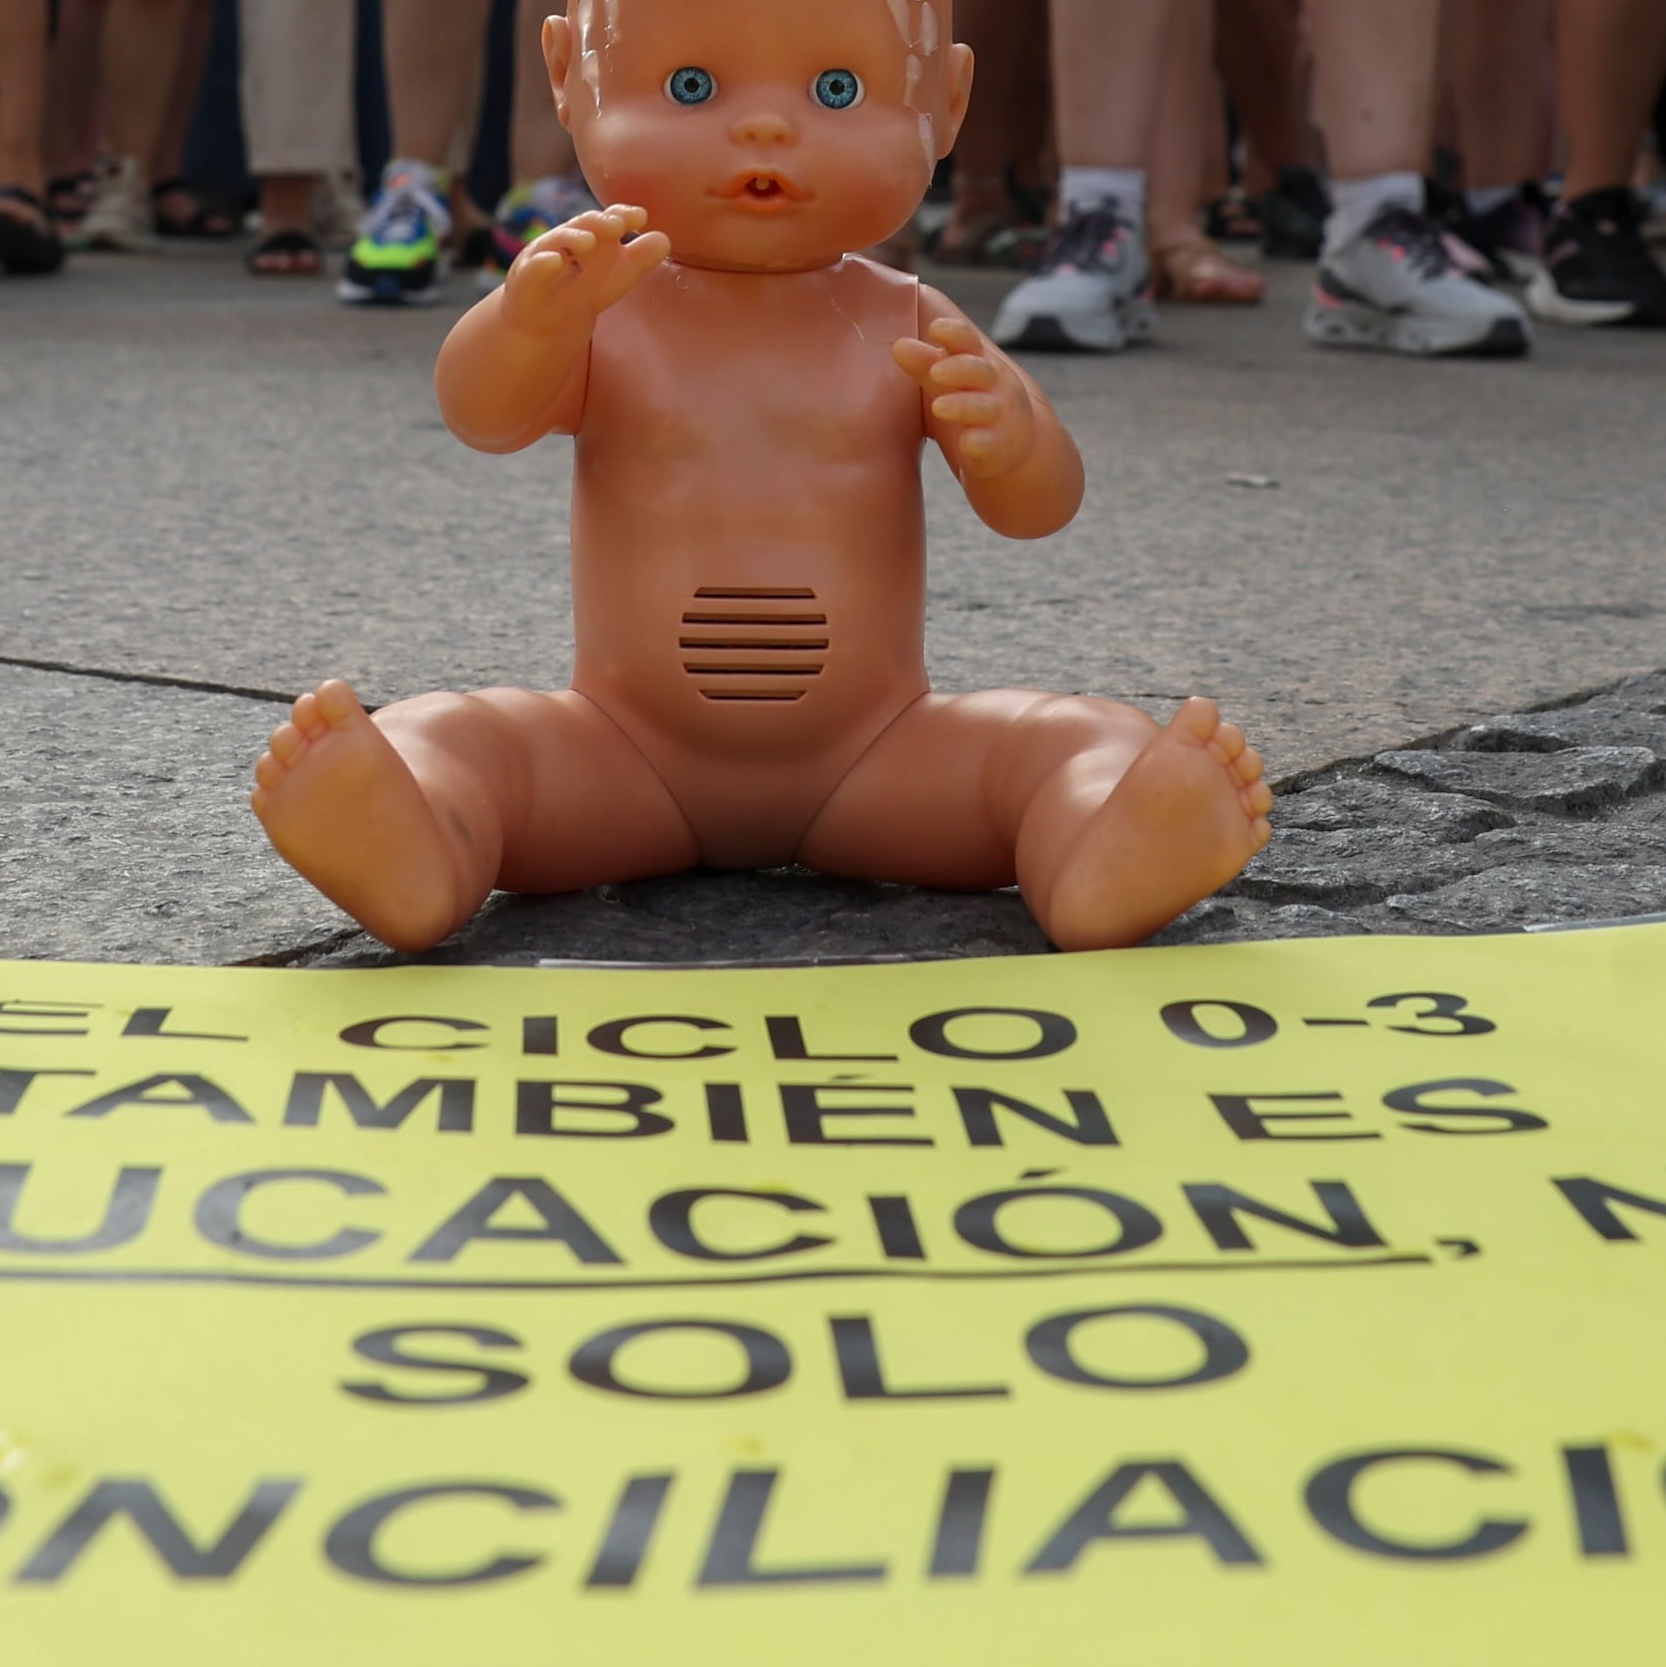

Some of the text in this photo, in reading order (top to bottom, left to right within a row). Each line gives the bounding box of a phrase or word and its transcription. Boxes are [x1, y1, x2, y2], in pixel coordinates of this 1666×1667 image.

[337, 1005, 1079, 1064] CICLO
[1159, 990, 1499, 1050] 0-3
[1206, 1076, 1551, 1144] ES
[341, 1302, 1252, 1407] SOLO
